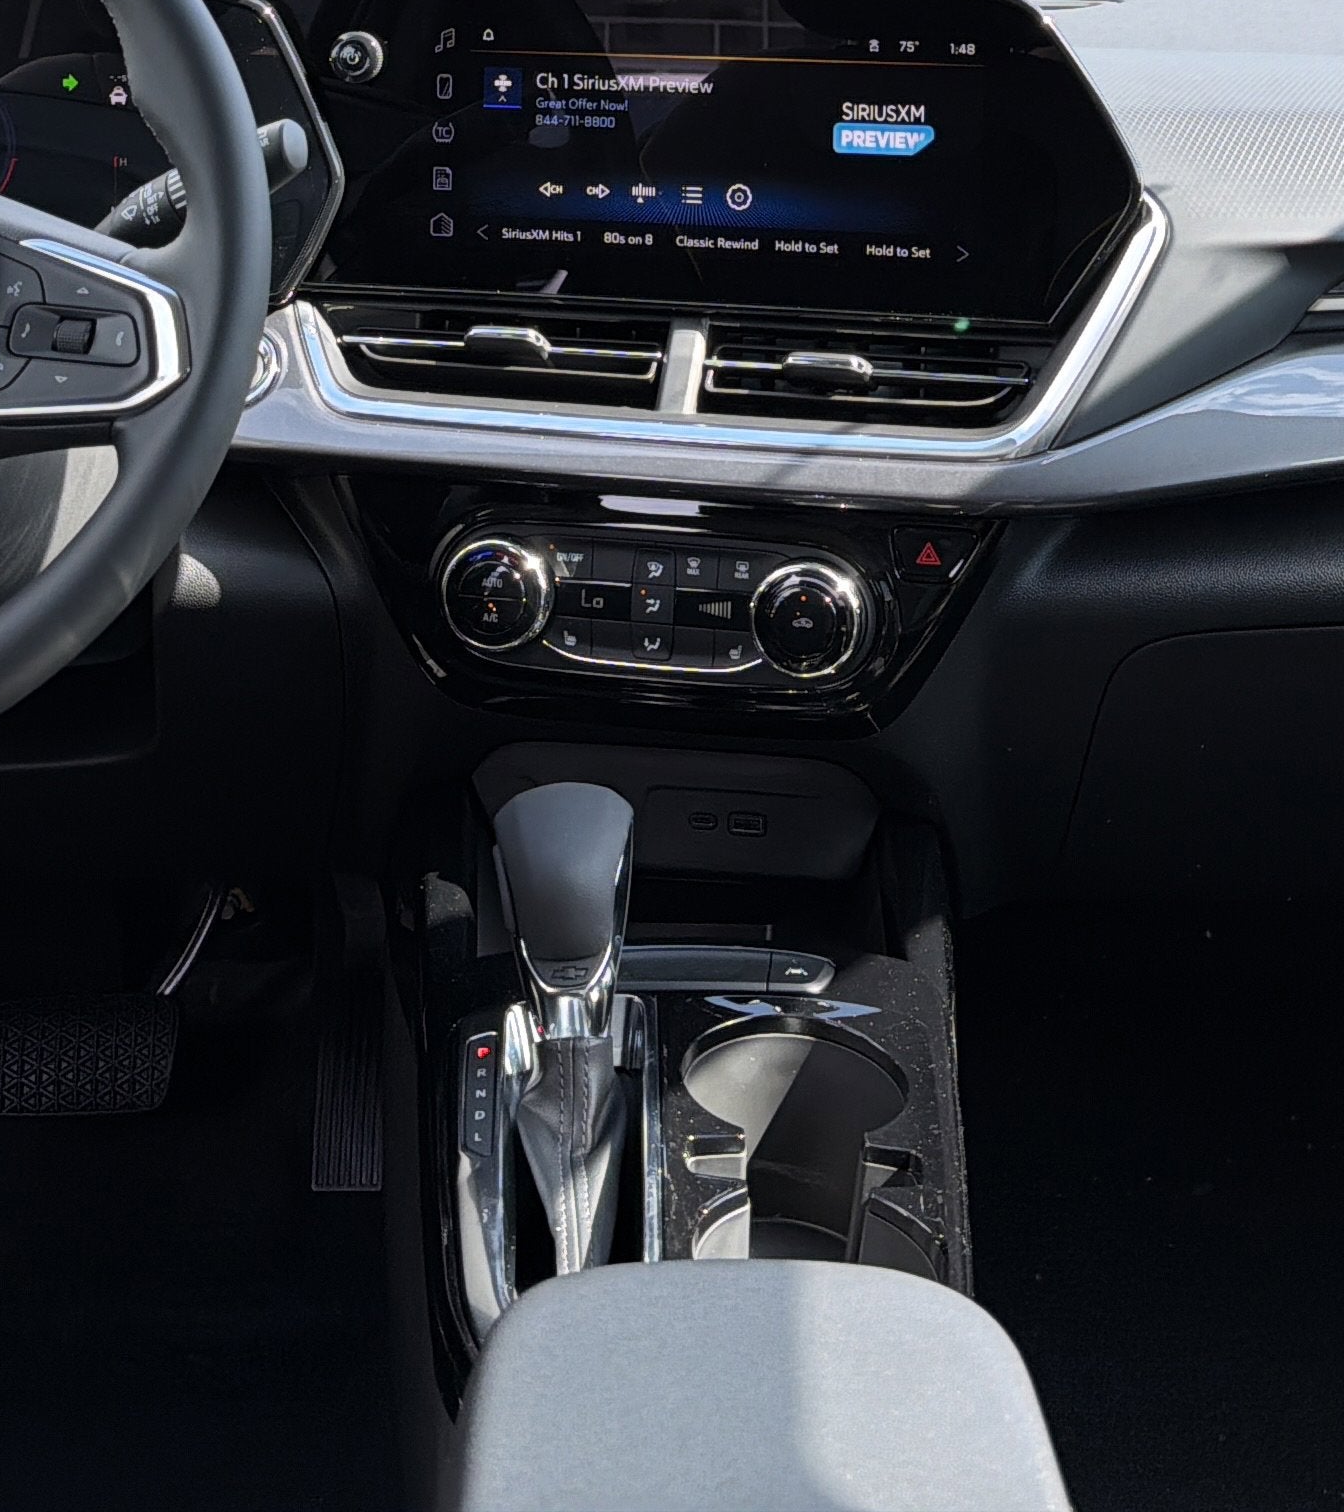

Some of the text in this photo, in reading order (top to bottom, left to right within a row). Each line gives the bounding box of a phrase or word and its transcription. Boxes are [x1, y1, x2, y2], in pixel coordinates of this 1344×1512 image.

[898, 40, 920, 53] 75°
[949, 42, 976, 56] 1:48
[536, 72, 714, 95] Ch 1 SiriusXM Preview
[535, 97, 629, 111] Great Offer Now!
[841, 101, 925, 123] SIRIUSXM
[535, 114, 616, 128] 844-711-8800
[841, 129, 926, 149] PREVIEW
[119, 157, 128, 167] H
[501, 228, 581, 243] SiriusXM Hits 1
[603, 232, 653, 246] 80s on 8
[675, 235, 759, 251] Classic Rewind
[775, 240, 839, 255] Hold to Set
[866, 244, 931, 259] Hold to Set
[481, 578, 503, 589] AUTO
[581, 588, 605, 609] Lo
[482, 613, 499, 623] A/C
[476, 1068, 487, 1078] R
[475, 1088, 487, 1098] N
[474, 1110, 486, 1121] D
[474, 1132, 483, 1142] L
